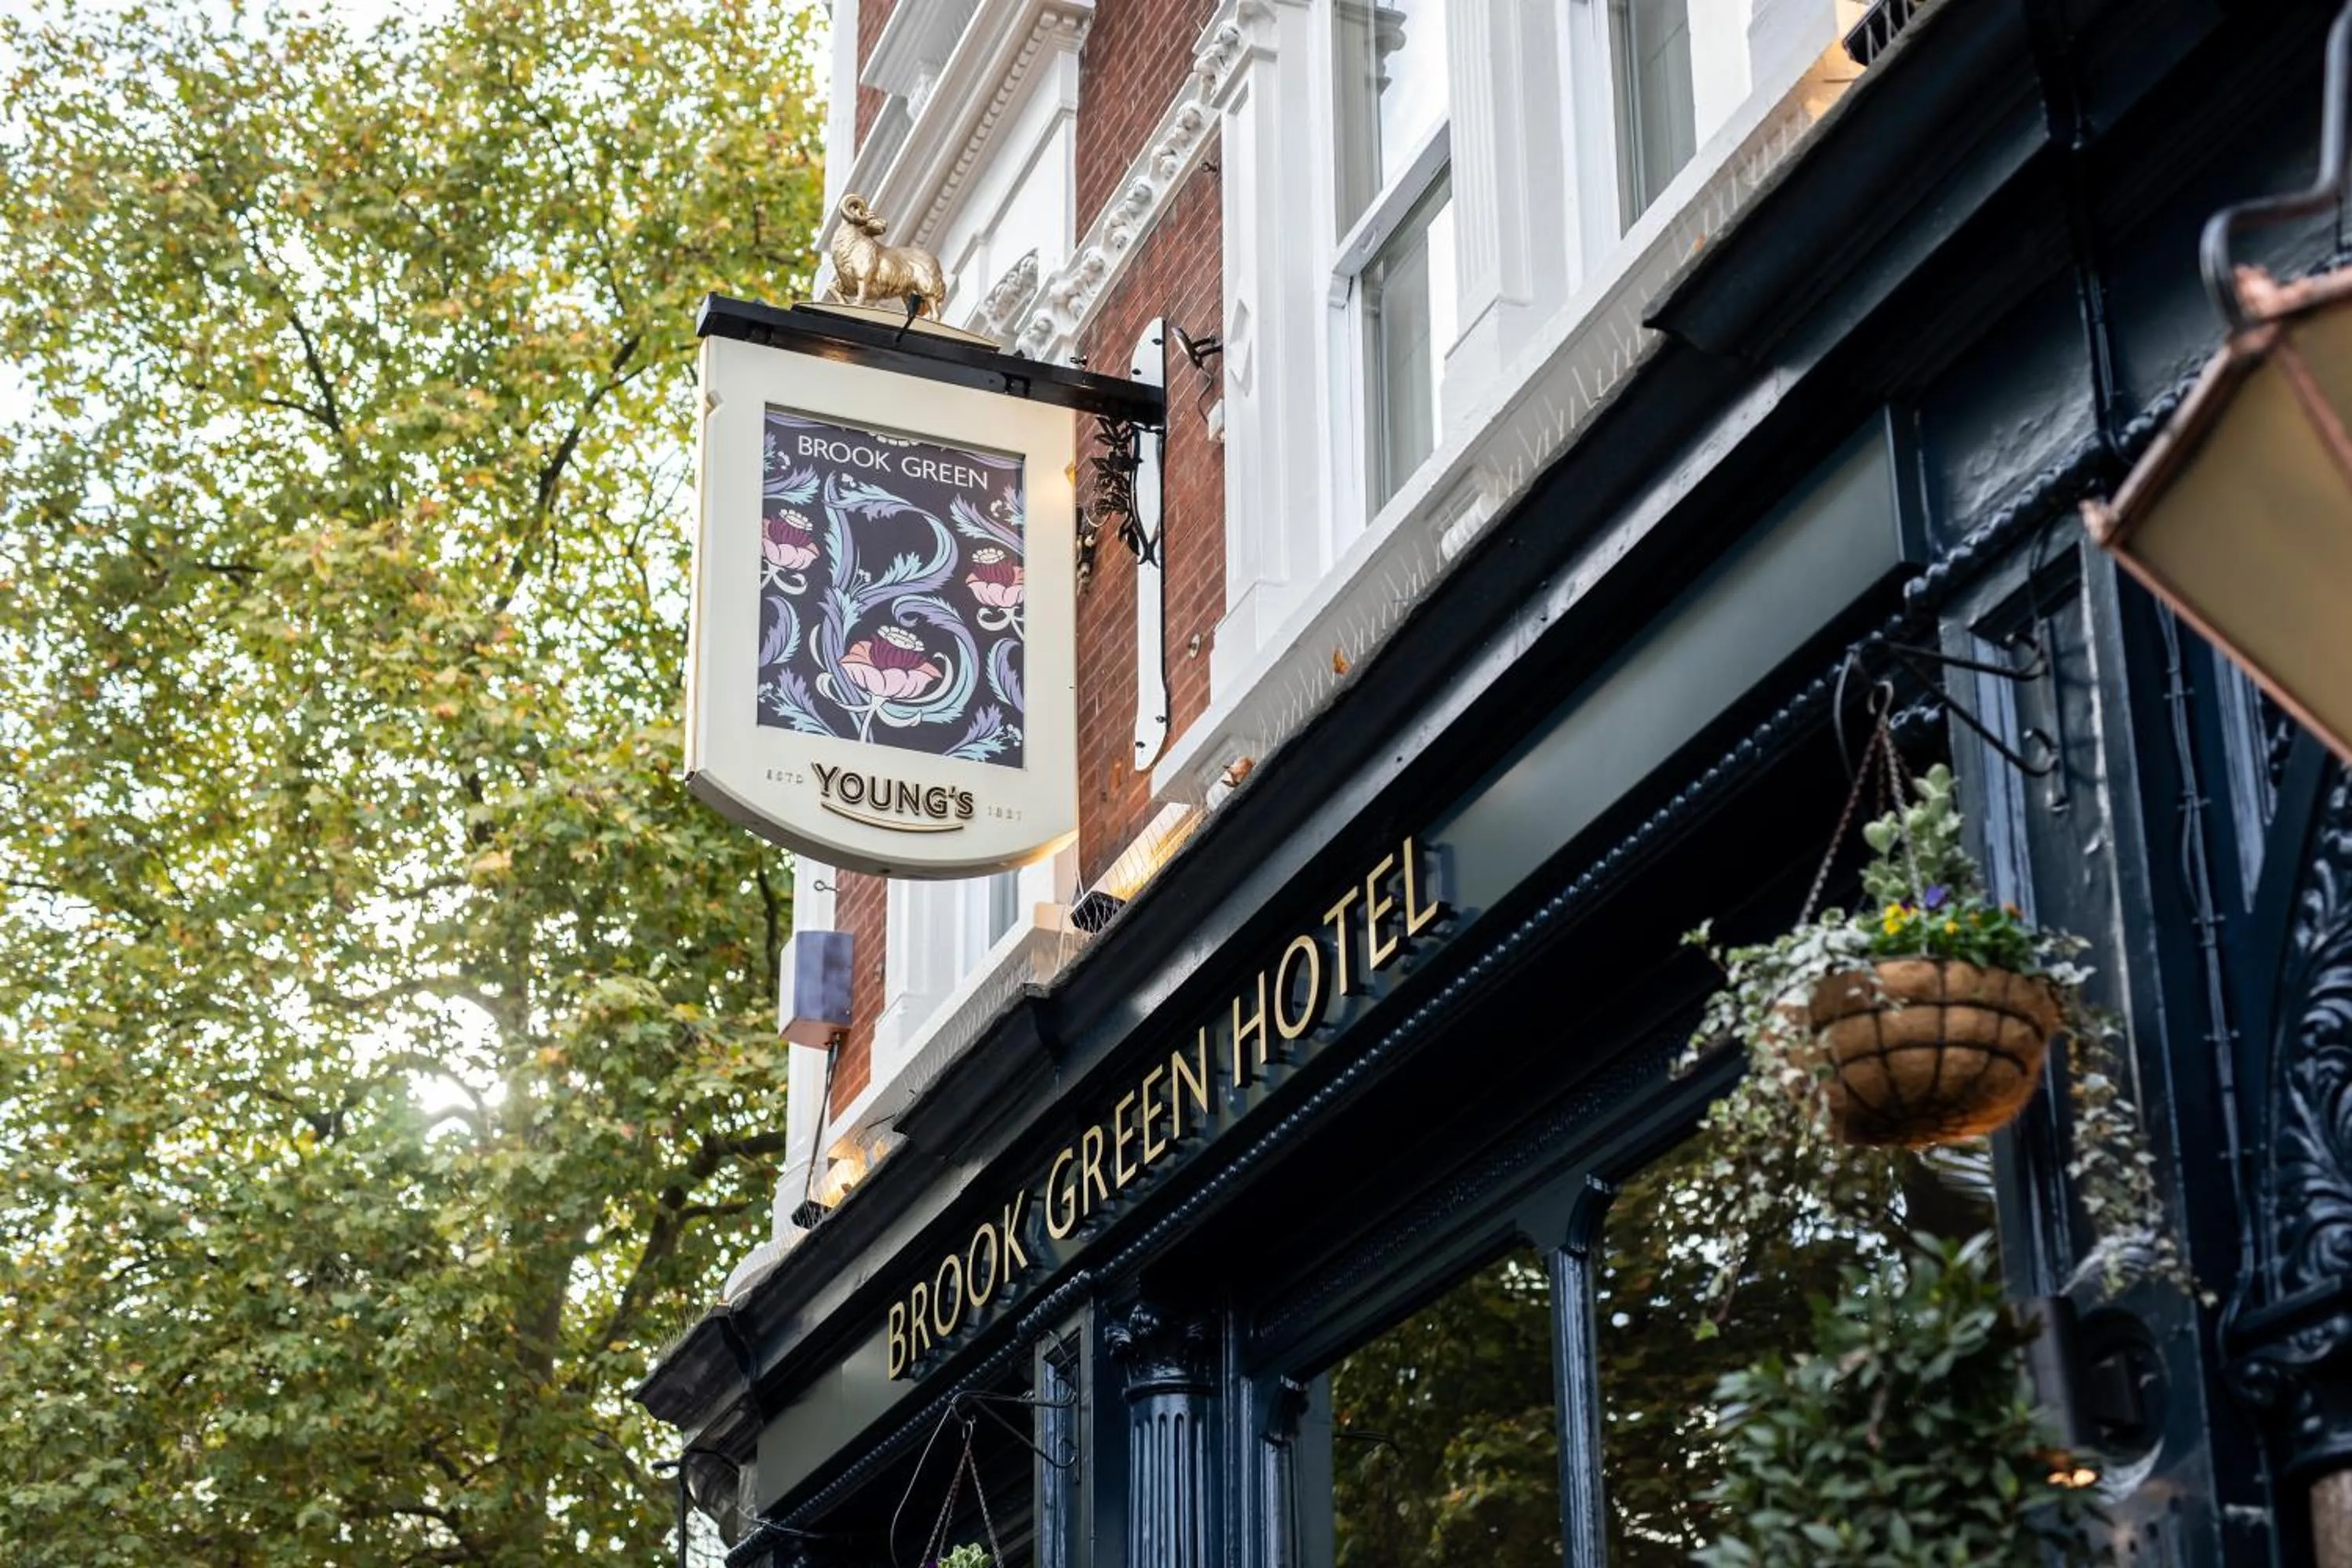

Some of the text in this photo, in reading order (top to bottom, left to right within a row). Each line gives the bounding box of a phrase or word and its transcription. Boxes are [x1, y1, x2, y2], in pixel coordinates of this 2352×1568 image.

[798, 435, 988, 490] BROOK GREEN
[811, 762, 975, 818] YOUNG'S
[889, 836, 1439, 1381] BROOK GREEN HOTEL
